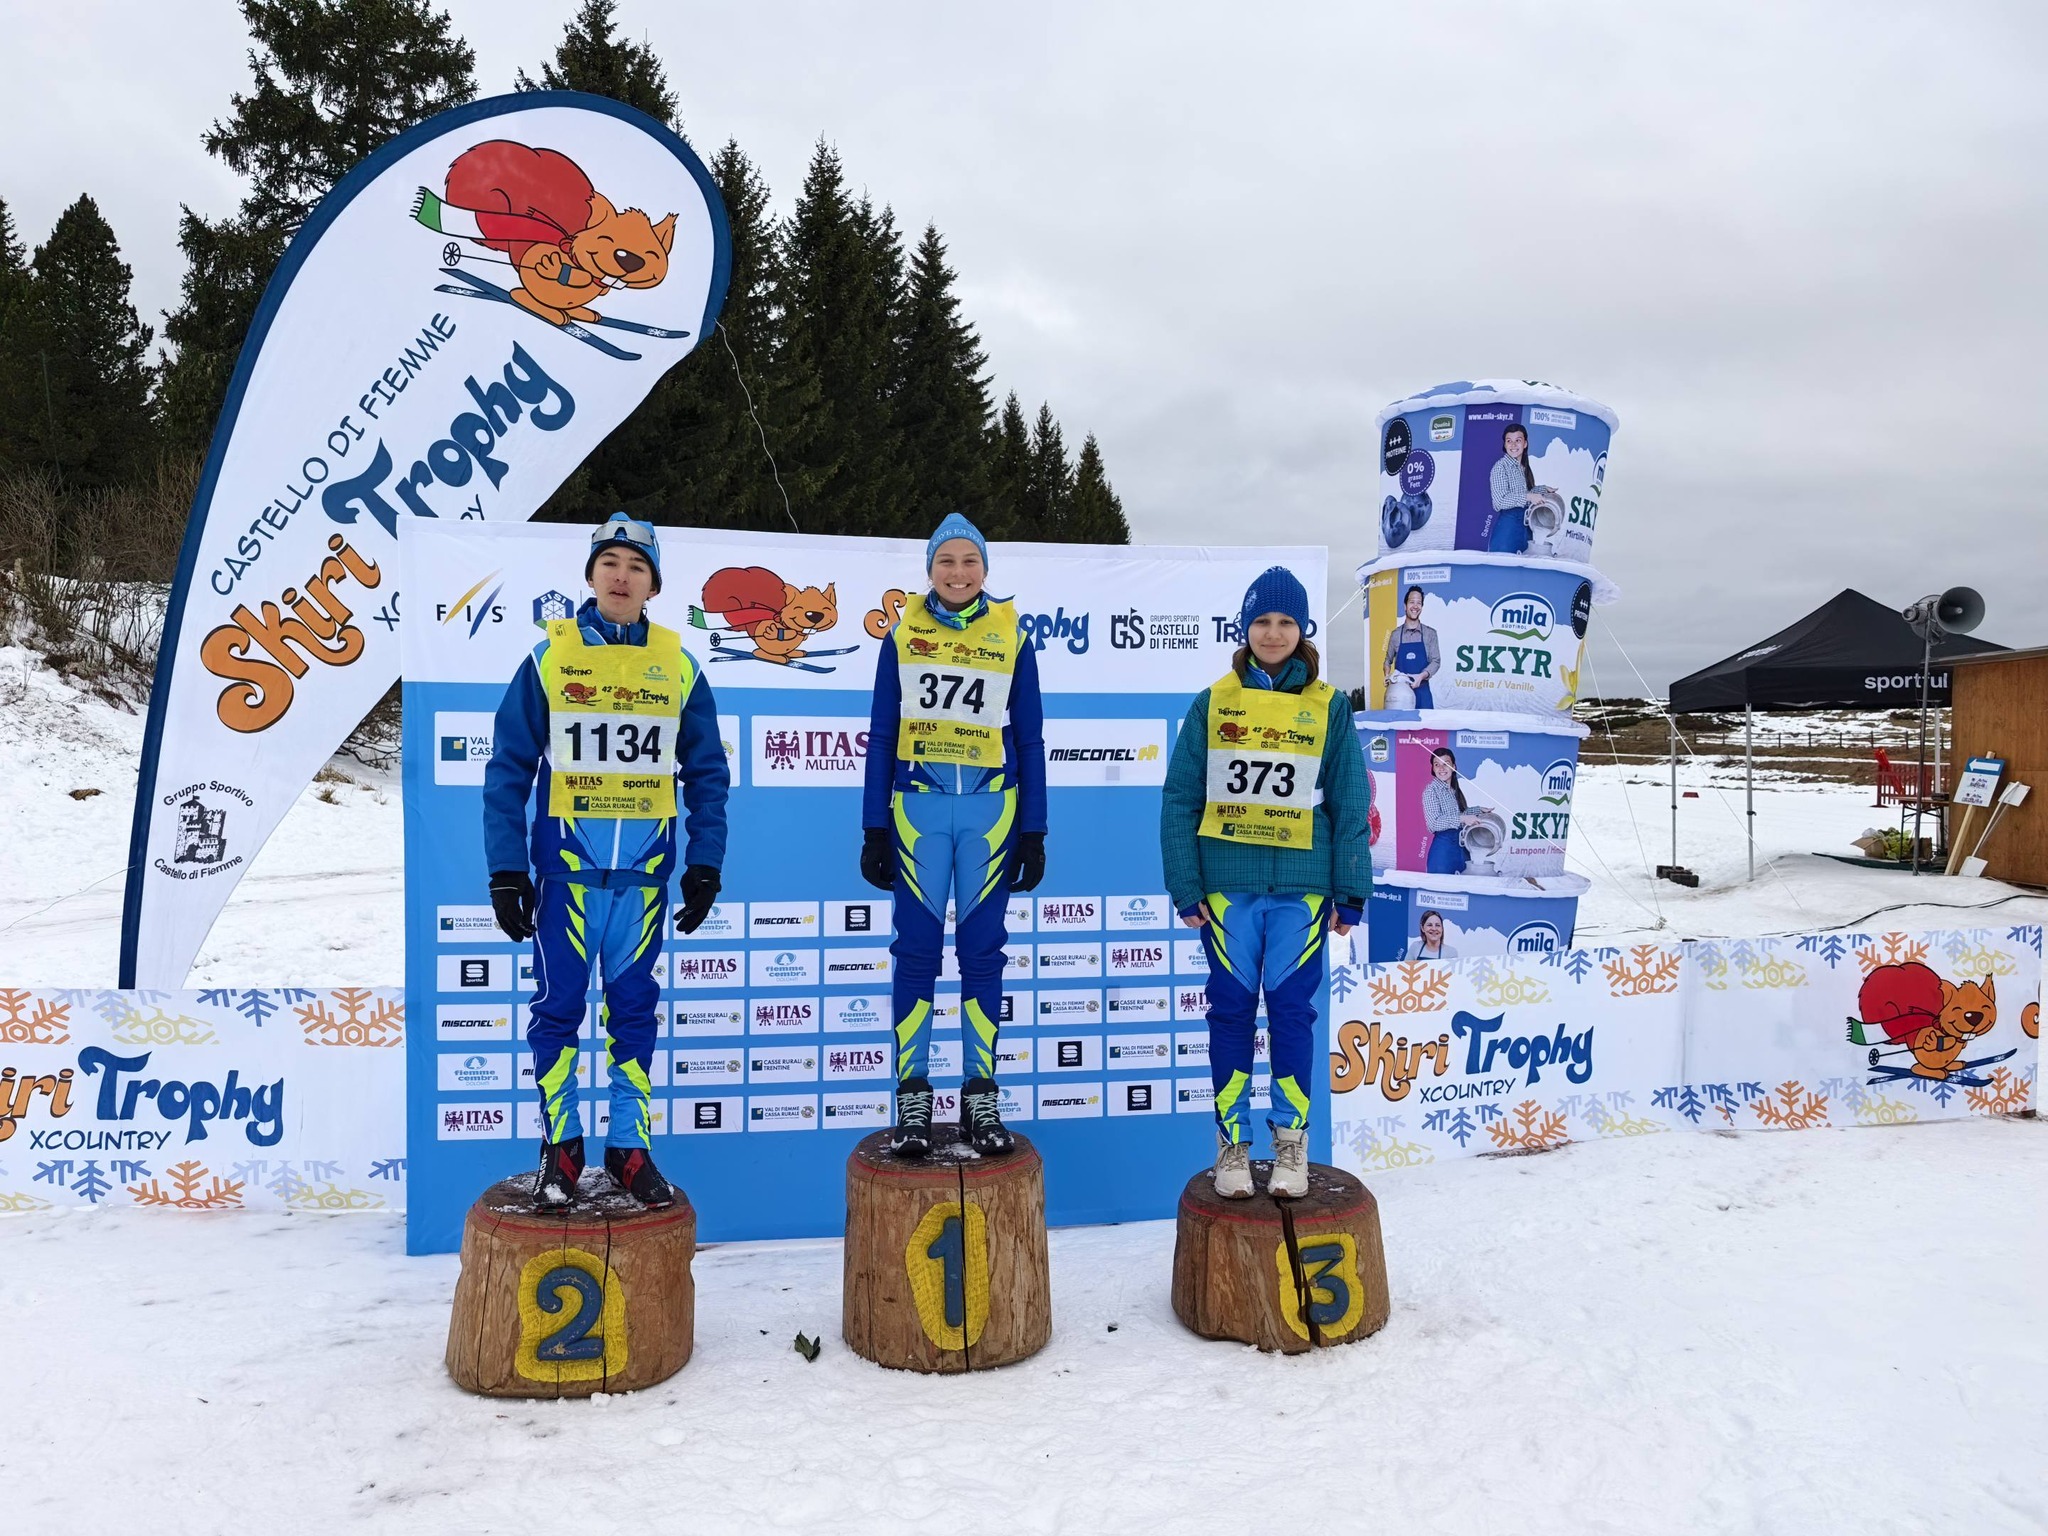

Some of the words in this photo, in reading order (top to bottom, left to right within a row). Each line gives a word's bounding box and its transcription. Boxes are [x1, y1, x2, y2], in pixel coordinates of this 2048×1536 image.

[1533, 411, 1550, 421] 100%
[211, 456, 329, 596] CASTELLO
[328, 413, 364, 458] DI
[360, 312, 458, 419] FIEMME
[1407, 461, 1425, 474] 0%
[1480, 513, 1493, 538] Sandra
[200, 533, 381, 734] Skiri
[322, 340, 576, 540] Trophy
[540, 591, 566, 605] FISI
[1150, 614, 1172, 623] GRUPPO
[1173, 614, 1200, 623] SPORTIVO
[1501, 604, 1547, 627] mila
[1018, 607, 1089, 655] ophy
[1150, 624, 1200, 636] CASTELLO
[1150, 638, 1161, 649] DI
[1162, 638, 1199, 649] FIEMME
[977, 647, 1005, 662] Trophy
[1455, 644, 1552, 678] SKYR
[559, 666, 592, 677] TRENTINO
[1455, 678, 1495, 690] Vaniglia
[1504, 680, 1535, 692] Vanille
[640, 688, 669, 705] Trophy
[919, 672, 985, 714] 374
[918, 722, 938, 732] ITAS
[954, 727, 990, 739] sportful
[470, 736, 490, 745] VAL
[565, 722, 661, 763] 1134
[804, 731, 870, 758] ITAS
[1460, 735, 1478, 744] 100%
[470, 747, 494, 756] CASS
[1049, 748, 1135, 761] MISCONEL
[805, 759, 857, 771] MUTUA
[579, 776, 603, 786] ITAS
[622, 779, 661, 790] sportful
[1226, 759, 1296, 797] 373
[1548, 771, 1572, 791] mila
[163, 782, 206, 807] Gruppo
[209, 780, 254, 808] Sportivo
[1227, 805, 1247, 815] ITAS
[1264, 808, 1301, 819] sportful
[1417, 836, 1428, 859] Sandra
[1510, 846, 1546, 856] Lampone
[154, 858, 188, 880] Castello
[188, 869, 199, 880] di
[200, 854, 244, 879] Fiemme
[1420, 894, 1436, 904] 100%
[1062, 903, 1095, 917] ITAS
[753, 917, 802, 925] MISCONEL
[1517, 931, 1554, 953] mila
[1130, 948, 1162, 961] ITAS
[701, 958, 737, 973] ITAS
[828, 963, 875, 971] MISCONEL
[701, 972, 729, 980] MUTUA
[776, 1004, 812, 1019] ITAS
[849, 1050, 884, 1064] ITAS
[1330, 1020, 1451, 1102] Skiri
[1451, 1010, 1595, 1088] Trophy
[849, 1064, 876, 1072] MUTUA
[0, 1067, 74, 1142] iri
[77, 1045, 284, 1147] Trophy
[1419, 1077, 1517, 1105] XCOUNTRY
[1041, 1098, 1087, 1106] MISCONEL
[466, 1110, 504, 1124] ITAS
[29, 1130, 172, 1151] XCOUNTRY
[926, 1216, 965, 1329] 1
[1299, 1244, 1351, 1325] 3
[535, 1267, 604, 1361] 2
